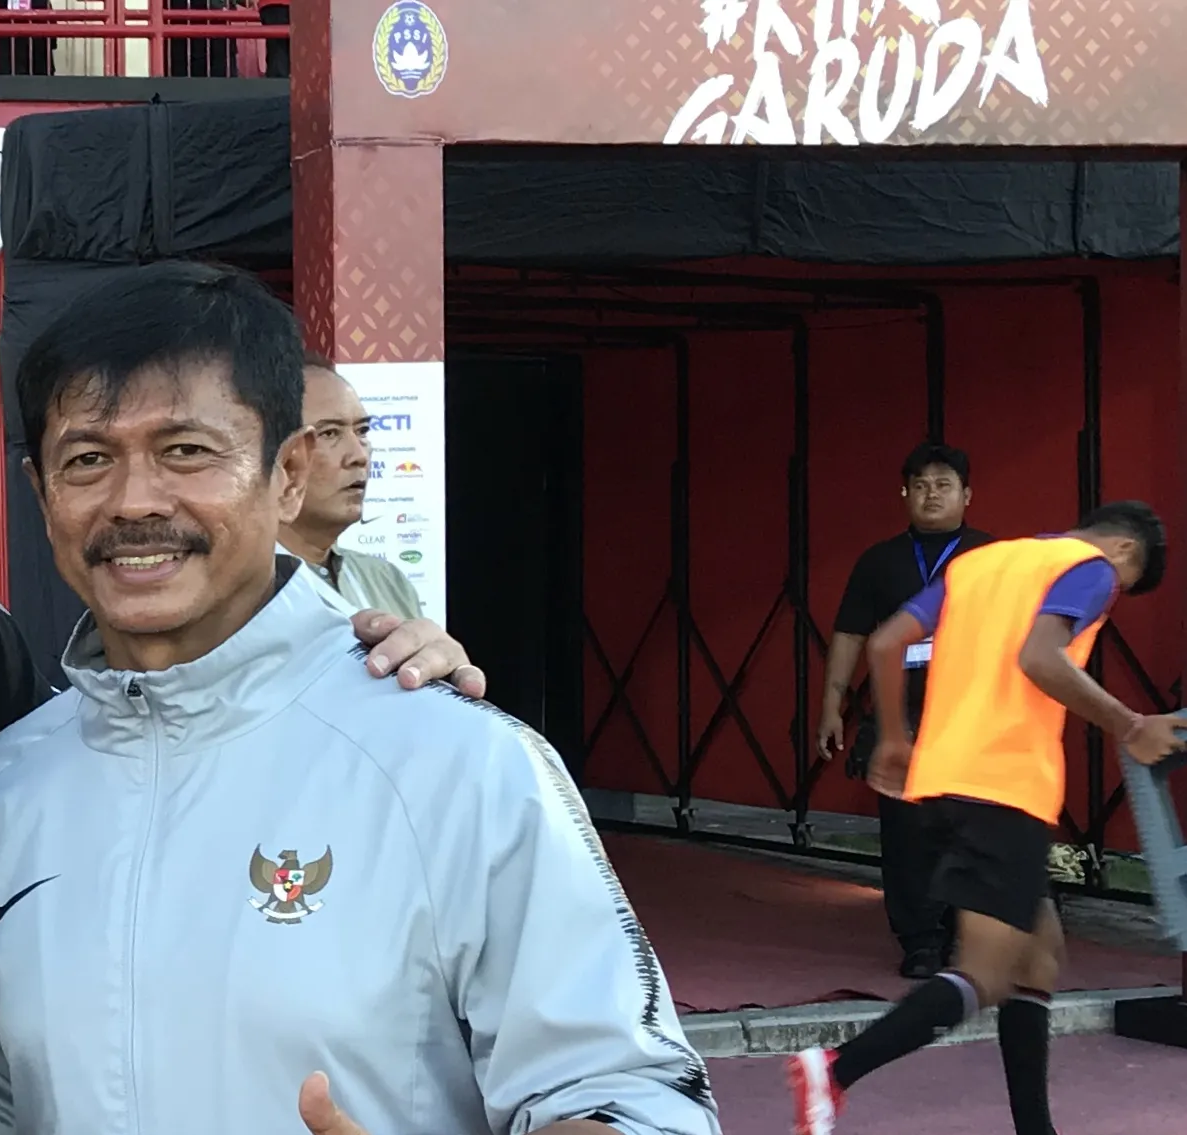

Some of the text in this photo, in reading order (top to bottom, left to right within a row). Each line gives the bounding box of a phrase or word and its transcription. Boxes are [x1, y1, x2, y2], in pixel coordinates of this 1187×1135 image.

[393, 29, 428, 44] PSSI
[663, 0, 1049, 145] GARUDA
[357, 534, 386, 545] CLEAR
